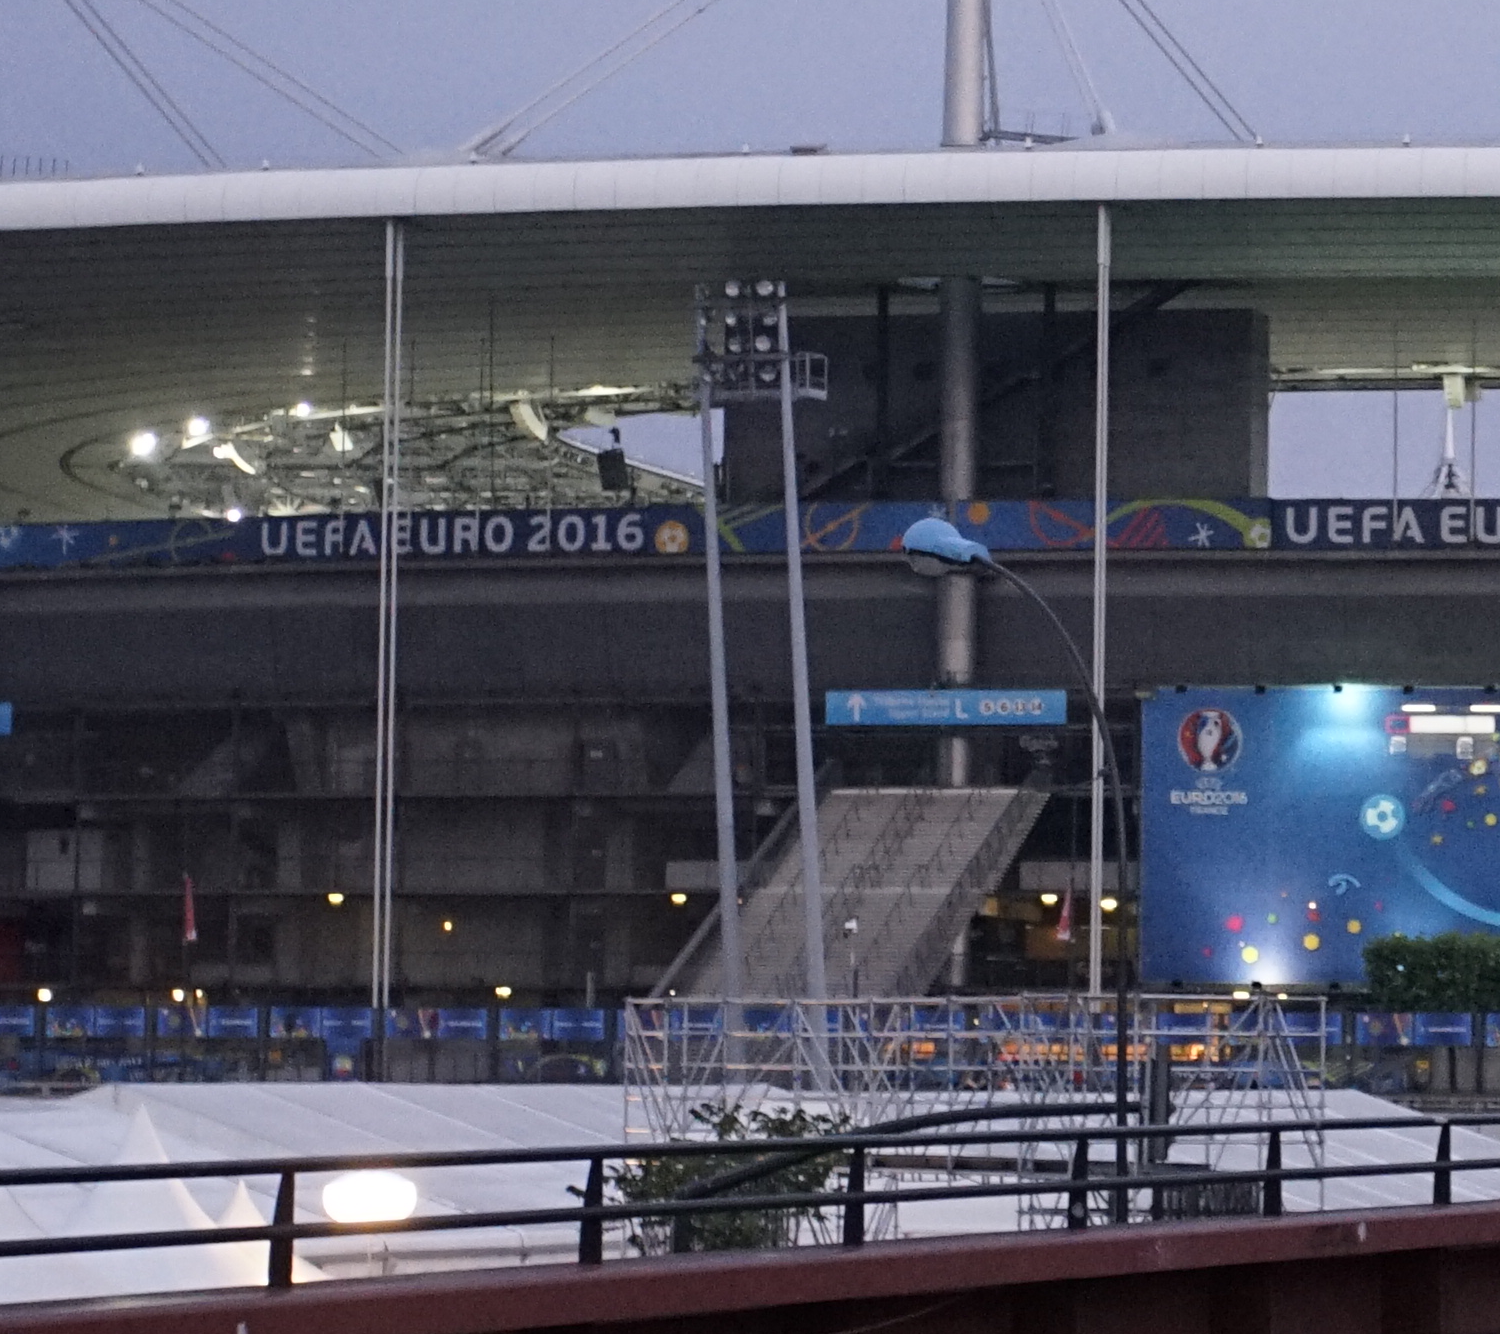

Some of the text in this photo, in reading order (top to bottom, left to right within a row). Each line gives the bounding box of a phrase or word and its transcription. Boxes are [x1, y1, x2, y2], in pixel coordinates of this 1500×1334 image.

[261, 513, 645, 556] UEFA EURO 2016
[1285, 506, 1425, 545] UEFA
[954, 698, 968, 719] L
